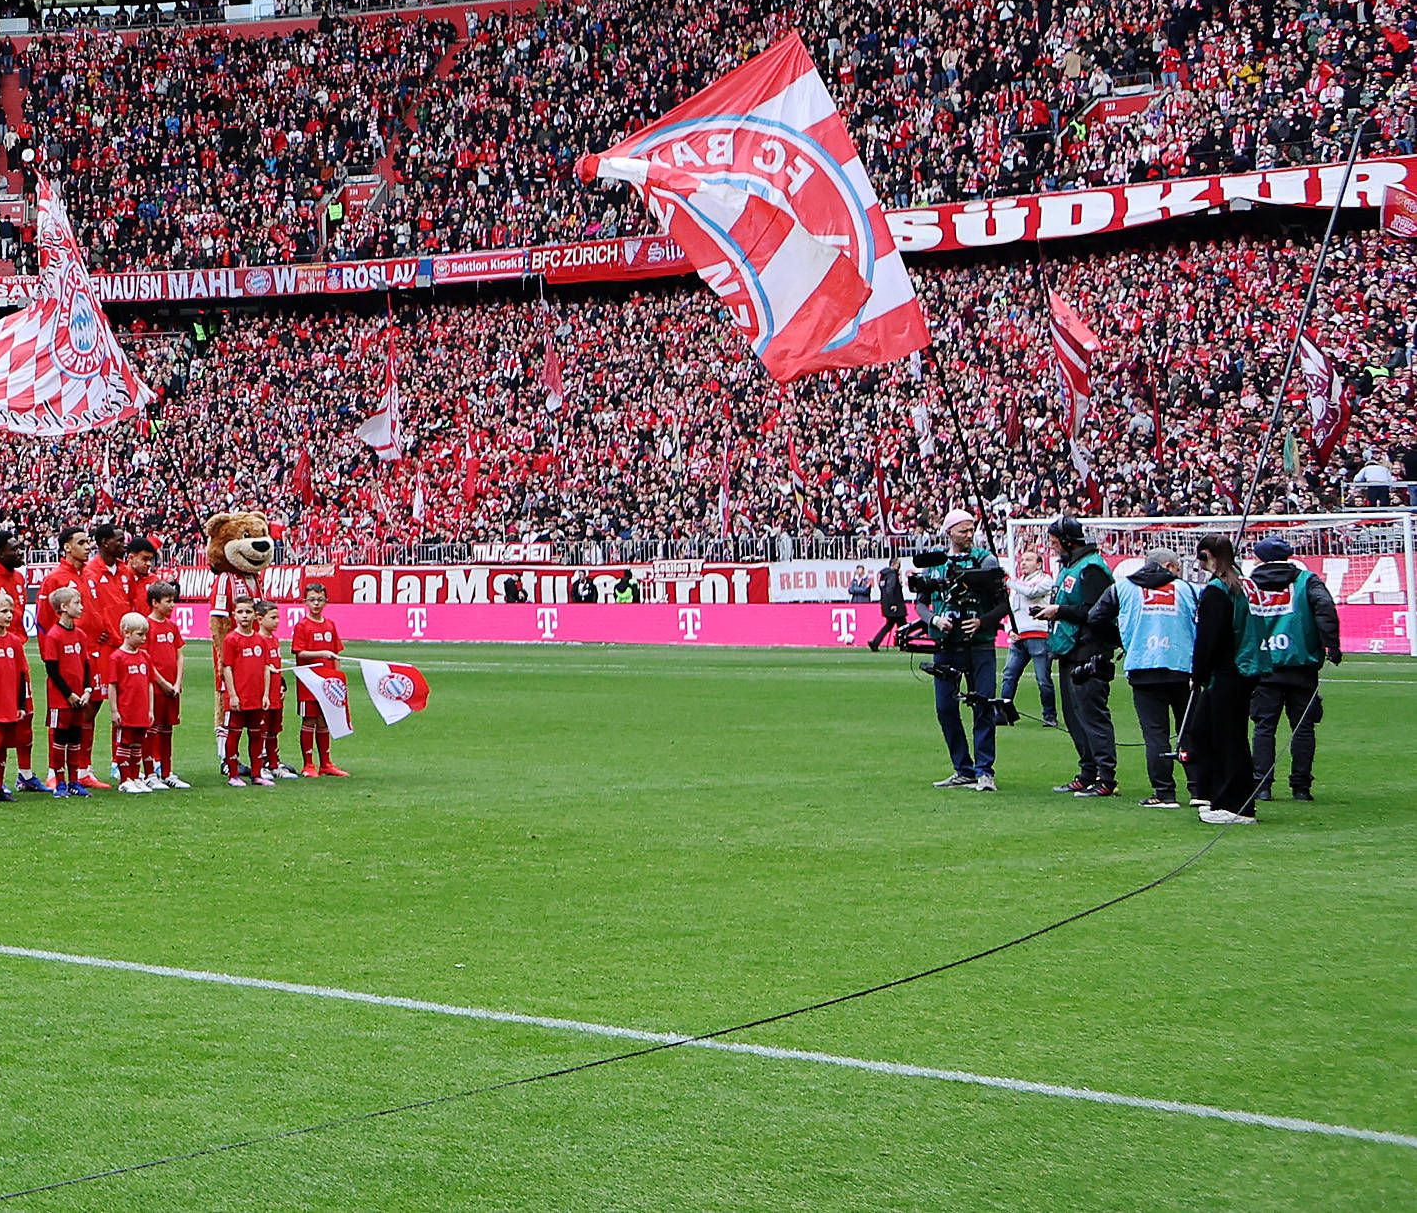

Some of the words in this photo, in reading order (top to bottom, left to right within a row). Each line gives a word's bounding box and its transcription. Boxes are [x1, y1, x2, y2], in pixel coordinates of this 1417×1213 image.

[532, 251, 561, 269] BFC
[563, 243, 618, 266] ZÜRICH
[168, 271, 243, 299] MAHL
[342, 263, 416, 290] RÖSLAU
[780, 570, 817, 590] RED
[175, 607, 193, 634] T
[407, 607, 427, 637] T
[537, 607, 559, 639] T
[678, 608, 702, 640] T
